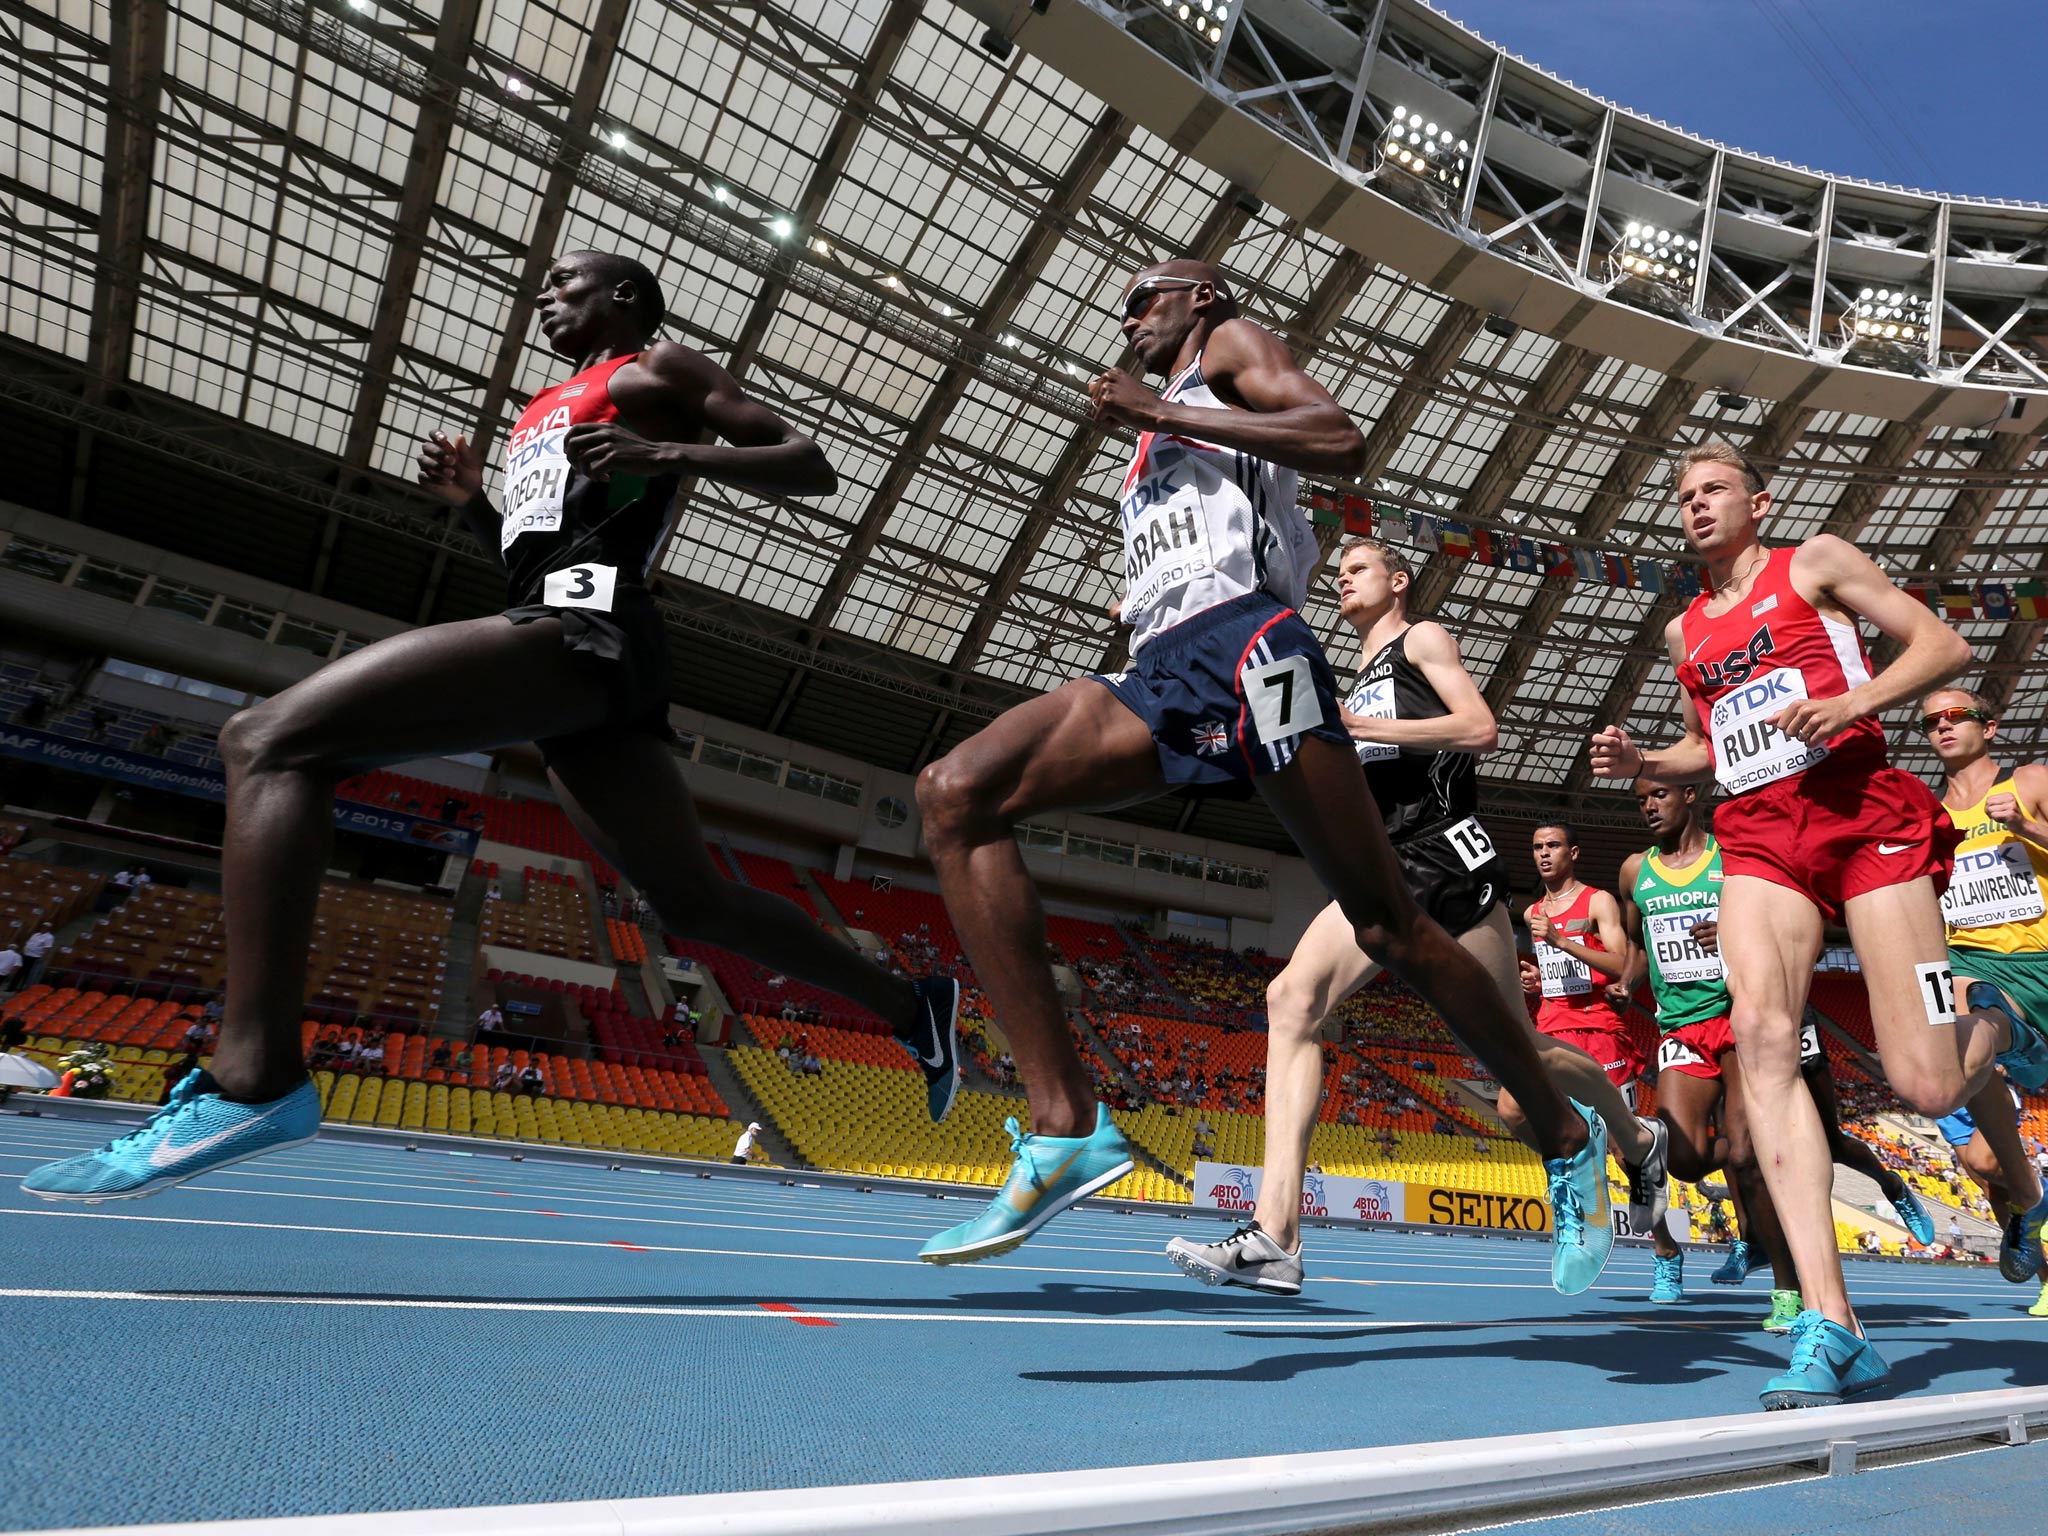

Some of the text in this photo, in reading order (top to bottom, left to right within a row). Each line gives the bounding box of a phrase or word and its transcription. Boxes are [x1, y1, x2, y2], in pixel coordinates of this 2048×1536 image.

[510, 433, 563, 477] TDK
[1121, 468, 1180, 530] TDK
[1127, 506, 1198, 588] ARAH
[566, 568, 595, 600] 3
[1161, 559, 1206, 587] 2013
[1696, 623, 1776, 686] USA
[1263, 669, 1294, 727] 7
[1726, 672, 1792, 716] TDK
[43, 741, 99, 764] World
[1365, 746, 1397, 759] 2013
[1786, 747, 1826, 770] 2013
[351, 812, 405, 832] 2013
[1453, 823, 1491, 860] 15
[1956, 847, 2019, 873] TDK
[1645, 891, 1720, 913] ETHIOPIA
[1949, 905, 2043, 927] MOSCOW 2013
[1544, 983, 1591, 995] OSCOW 2013
[1661, 1039, 1687, 1064] 12
[1429, 1189, 1546, 1231] SEIKO
